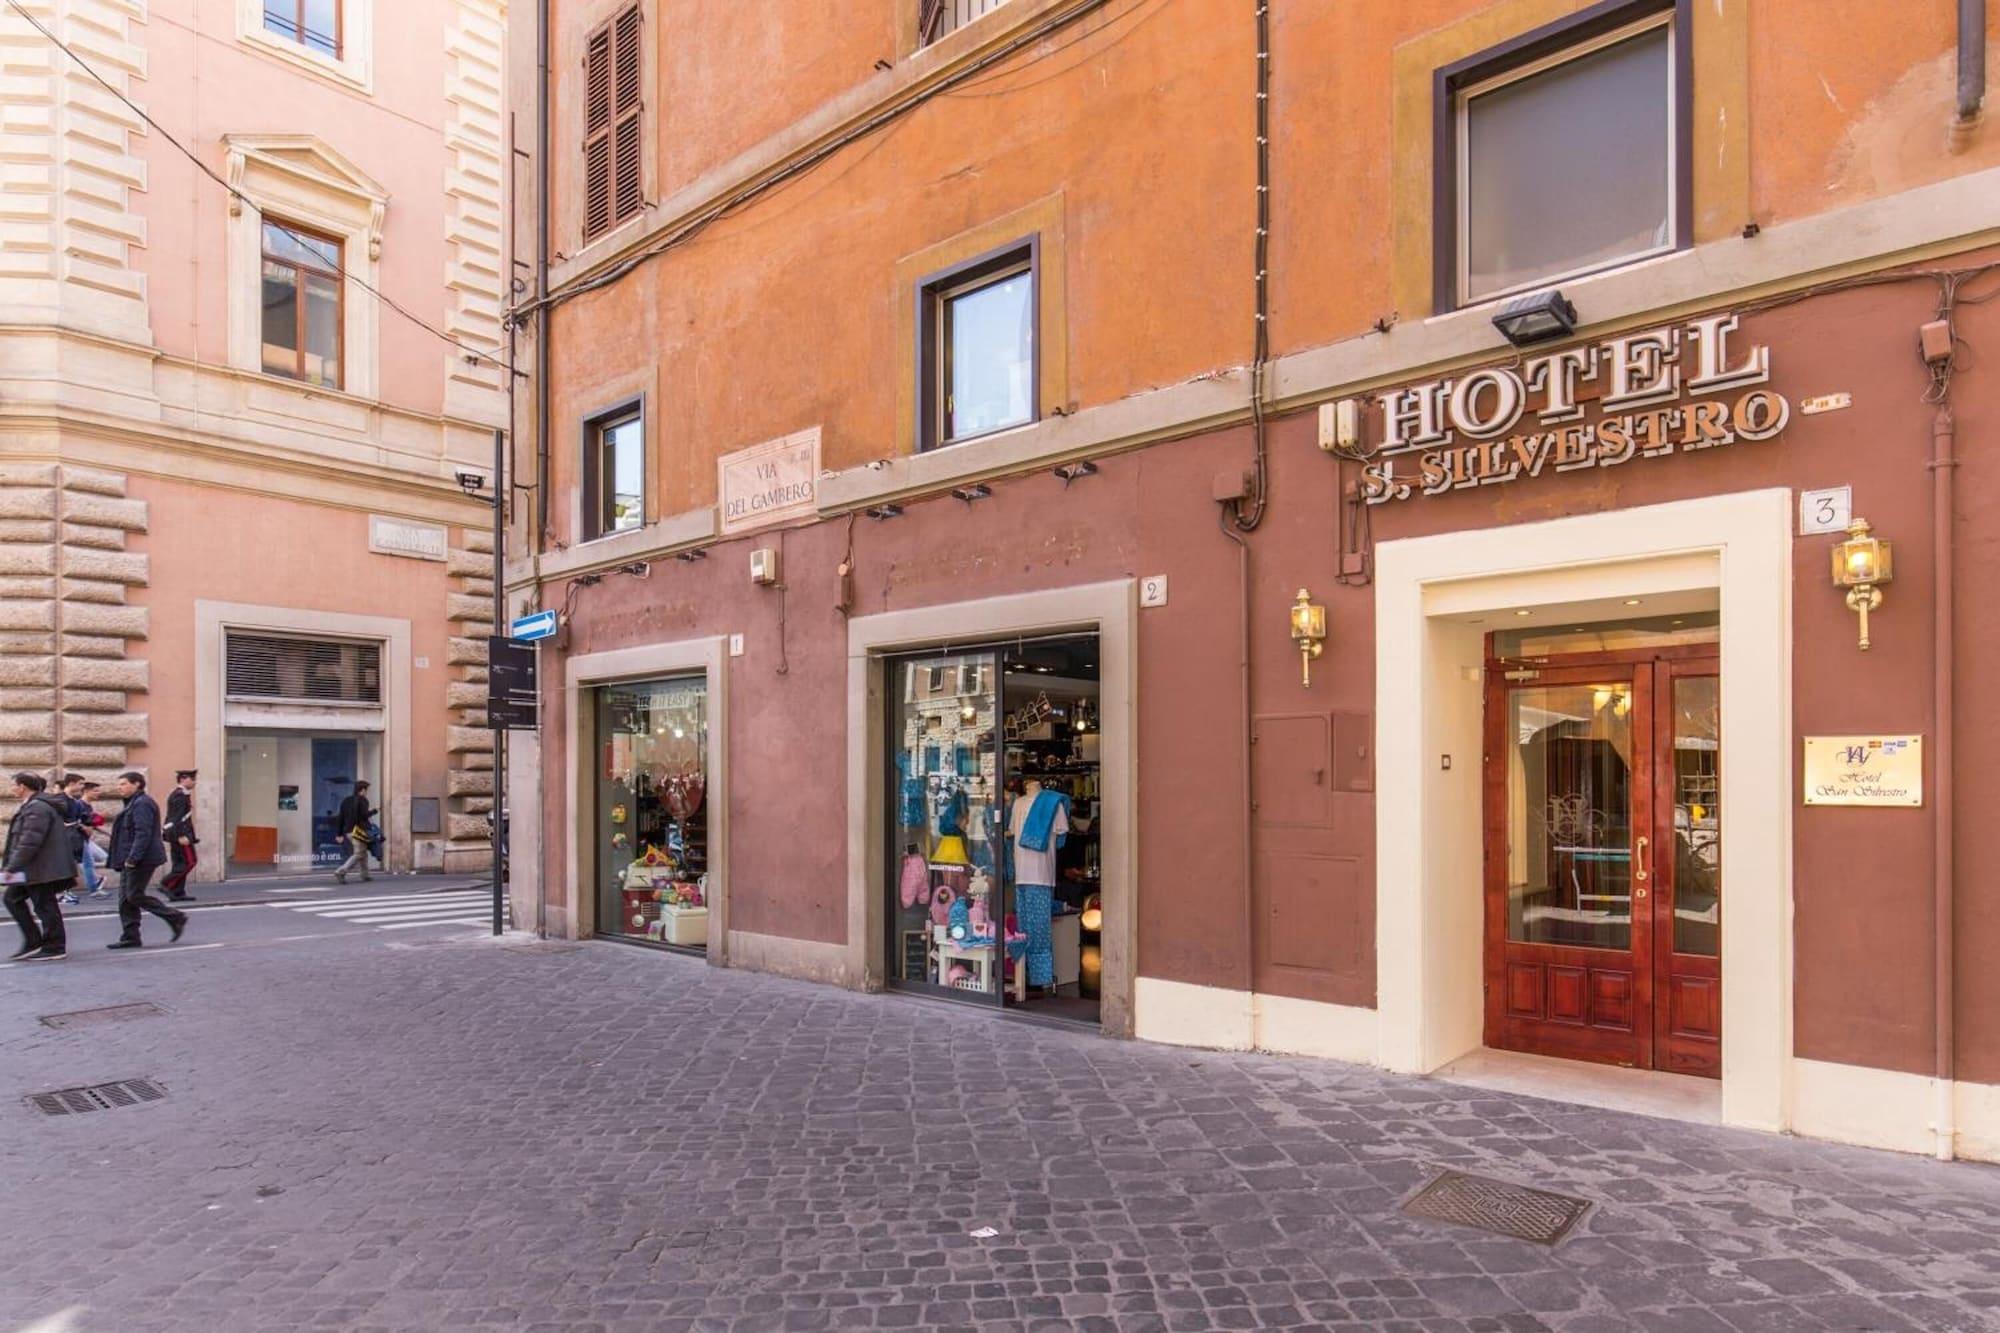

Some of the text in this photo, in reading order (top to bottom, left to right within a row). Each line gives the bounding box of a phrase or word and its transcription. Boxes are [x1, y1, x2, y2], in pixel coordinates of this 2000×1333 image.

[1379, 312, 1768, 455] HOTEL
[1361, 390, 1790, 504] S. SILVESTRO
[756, 463, 777, 479] VIA
[727, 480, 814, 517] DEL GAMBERO
[1816, 497, 1835, 524] 3
[1147, 582, 1157, 600] 2
[1839, 771, 1882, 784] Hotel
[1815, 785, 1908, 797] San Silvestro
